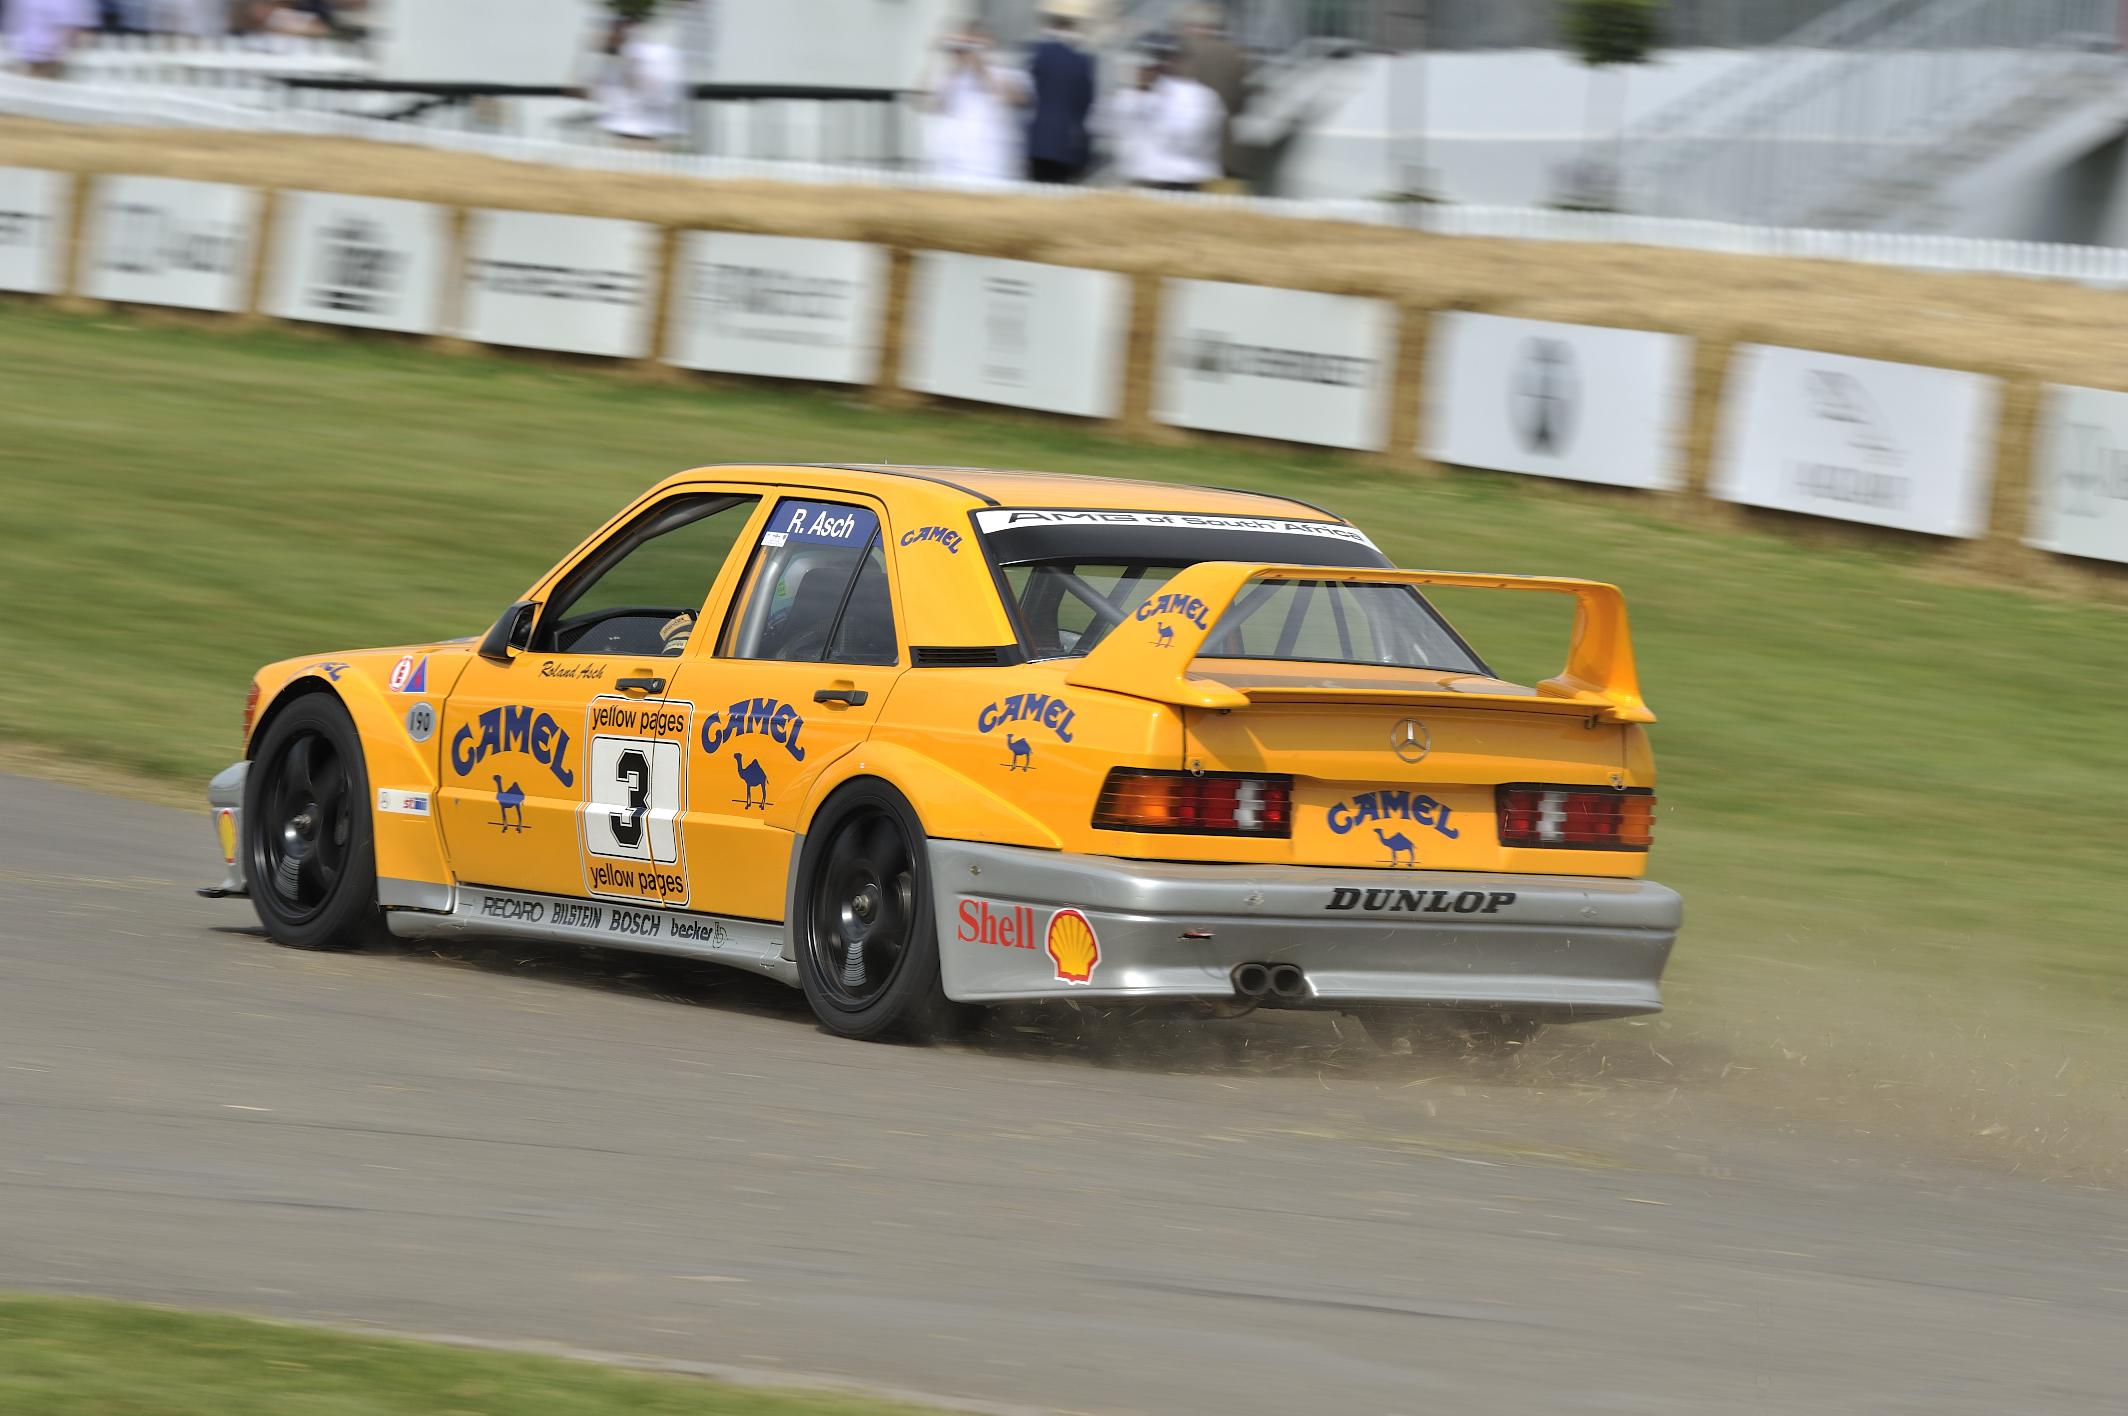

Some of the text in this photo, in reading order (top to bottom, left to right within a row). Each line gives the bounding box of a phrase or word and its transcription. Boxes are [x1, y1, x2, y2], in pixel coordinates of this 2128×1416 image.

[787, 508, 855, 539] R. Asch
[900, 526, 964, 554] CAMEL
[1008, 512, 1366, 542] AMG of South Africa
[1136, 593, 1209, 630] CAMEL
[538, 660, 608, 680] Roland Asch
[409, 710, 431, 733] 190
[591, 705, 684, 736] yellow pages
[700, 697, 805, 762] CAMEL
[978, 693, 1076, 743] CAMEL
[451, 704, 574, 788] CAMEL
[609, 747, 652, 849] 3
[1327, 789, 1460, 839] CAMEL
[590, 863, 684, 896] yellow pages
[1325, 887, 1516, 914] DUNLOP
[481, 896, 713, 941] RECARO BILSTEIN BOSCH becker
[957, 898, 1036, 950] Shell
